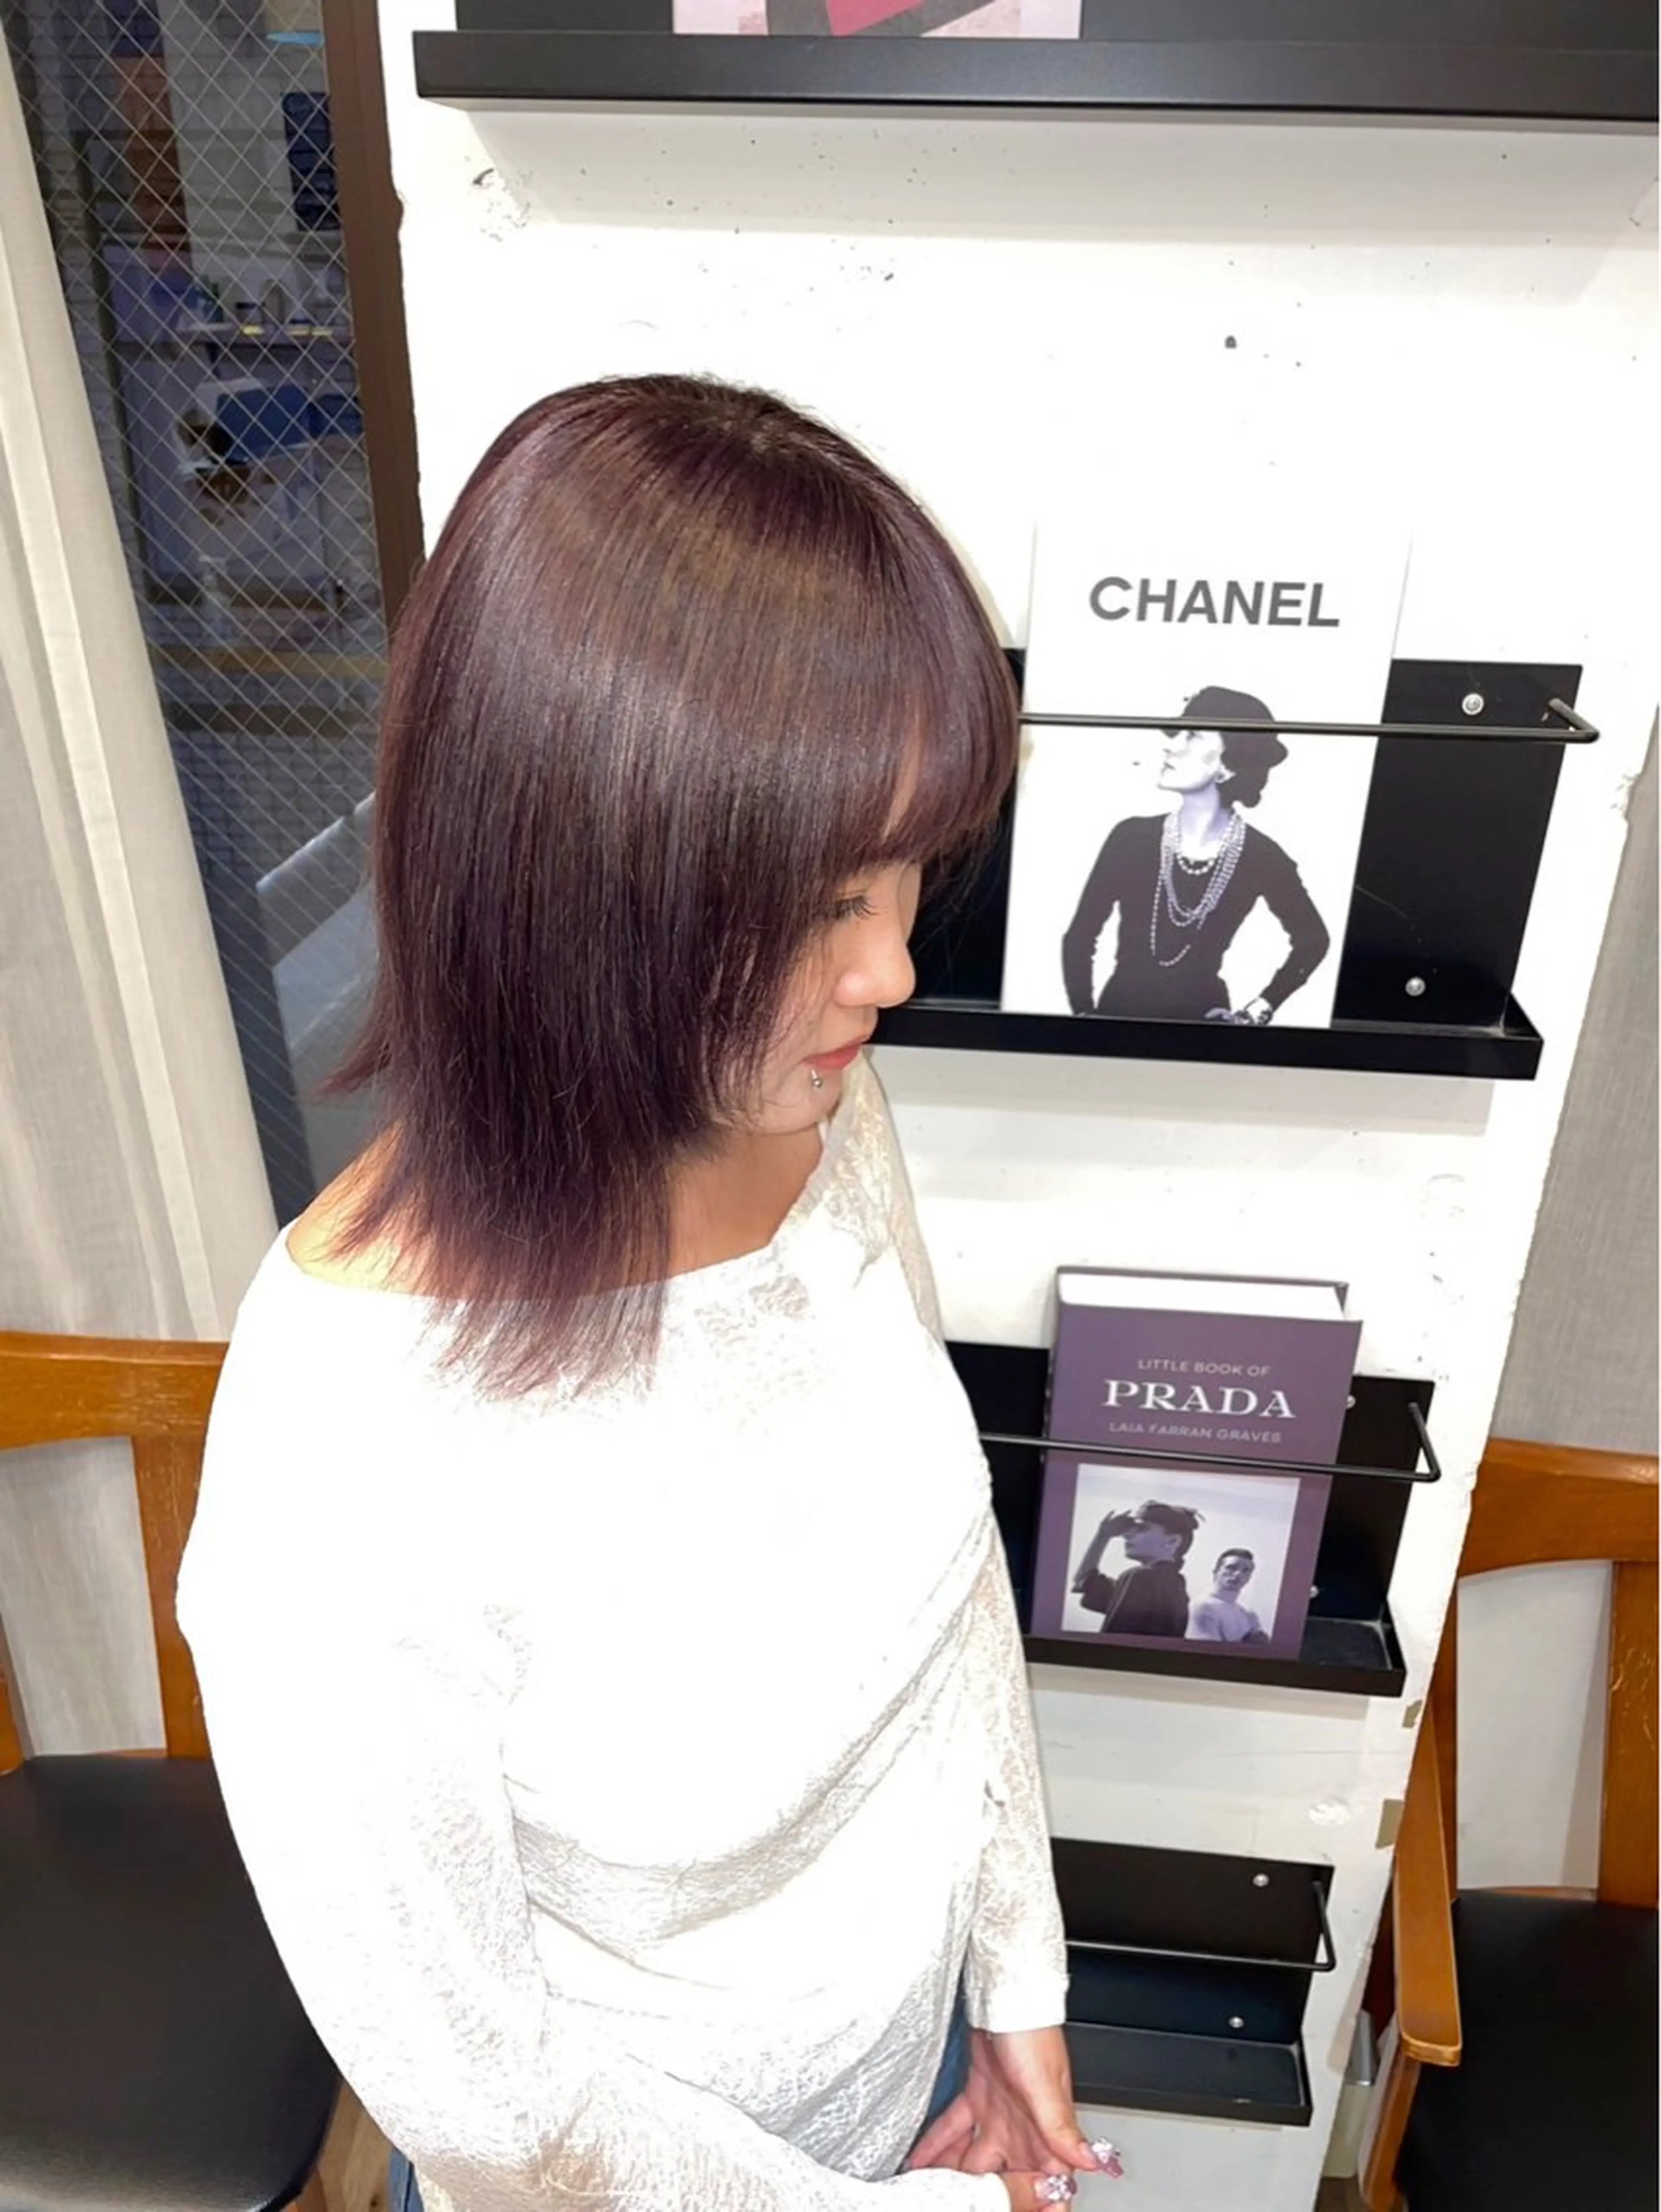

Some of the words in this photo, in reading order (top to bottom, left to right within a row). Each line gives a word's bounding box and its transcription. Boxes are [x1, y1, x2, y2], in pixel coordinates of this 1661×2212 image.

[1090, 576, 1340, 628] CHANEL
[1138, 1359, 1189, 1372] LITTLE
[1193, 1362, 1242, 1376] BOOK
[1246, 1365, 1271, 1377] OF
[1101, 1378, 1296, 1418] PRADA
[1109, 1422, 1145, 1433] LAIA
[1149, 1423, 1212, 1439] FARRAN
[1216, 1429, 1282, 1443] GRAVES
